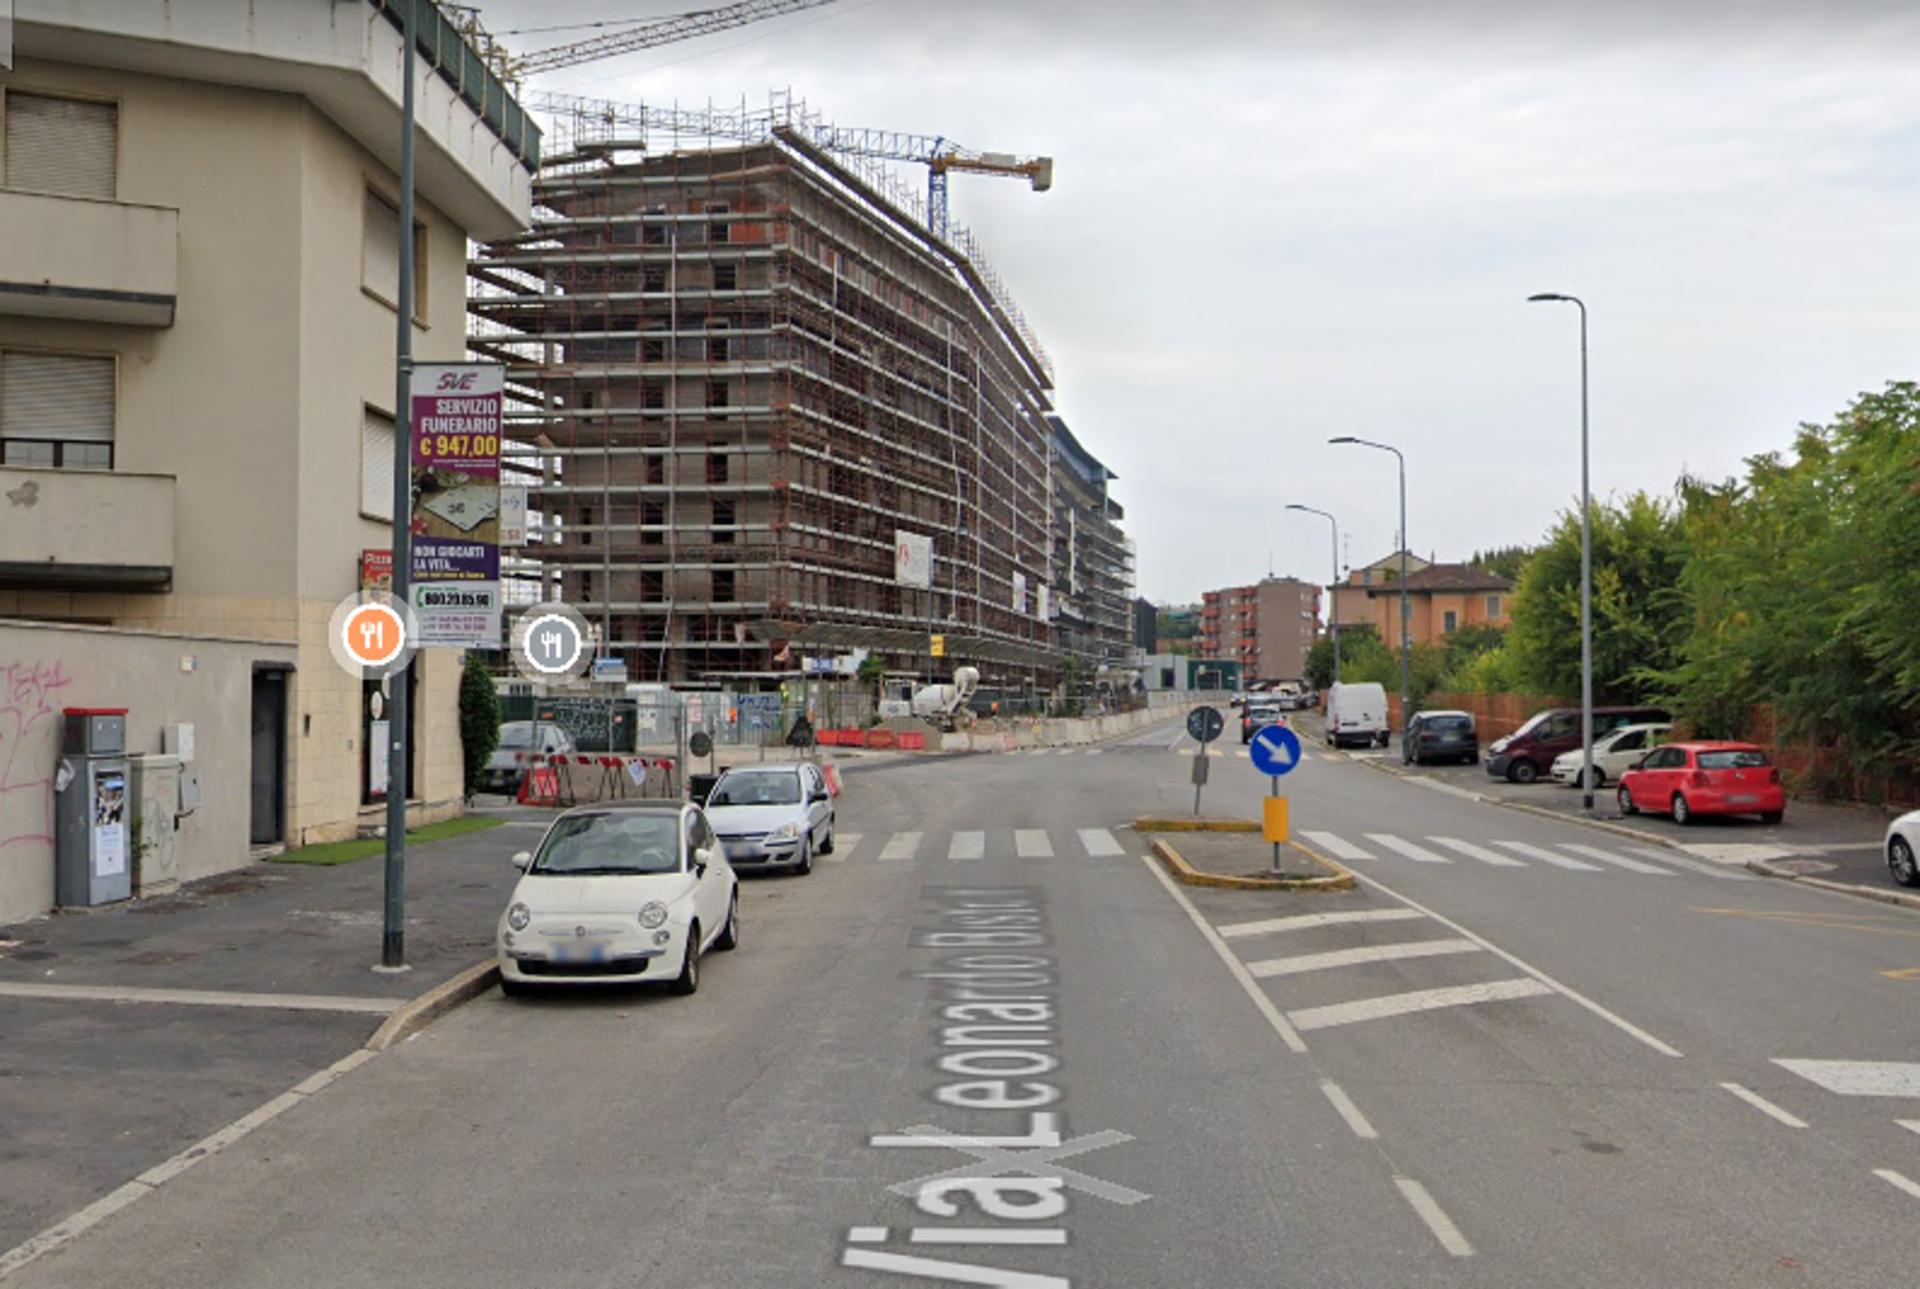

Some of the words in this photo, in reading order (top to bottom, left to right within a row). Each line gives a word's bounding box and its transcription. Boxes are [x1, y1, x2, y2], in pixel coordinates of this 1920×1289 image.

[436, 372, 478, 390] SVE
[436, 399, 497, 414] SERVIZIO
[421, 417, 497, 433] FUNERARIO
[420, 437, 432, 456] €
[436, 435, 497, 457] 947,00
[413, 546, 436, 558] NON
[437, 545, 485, 558] GIOCARTI
[413, 558, 427, 569] LA
